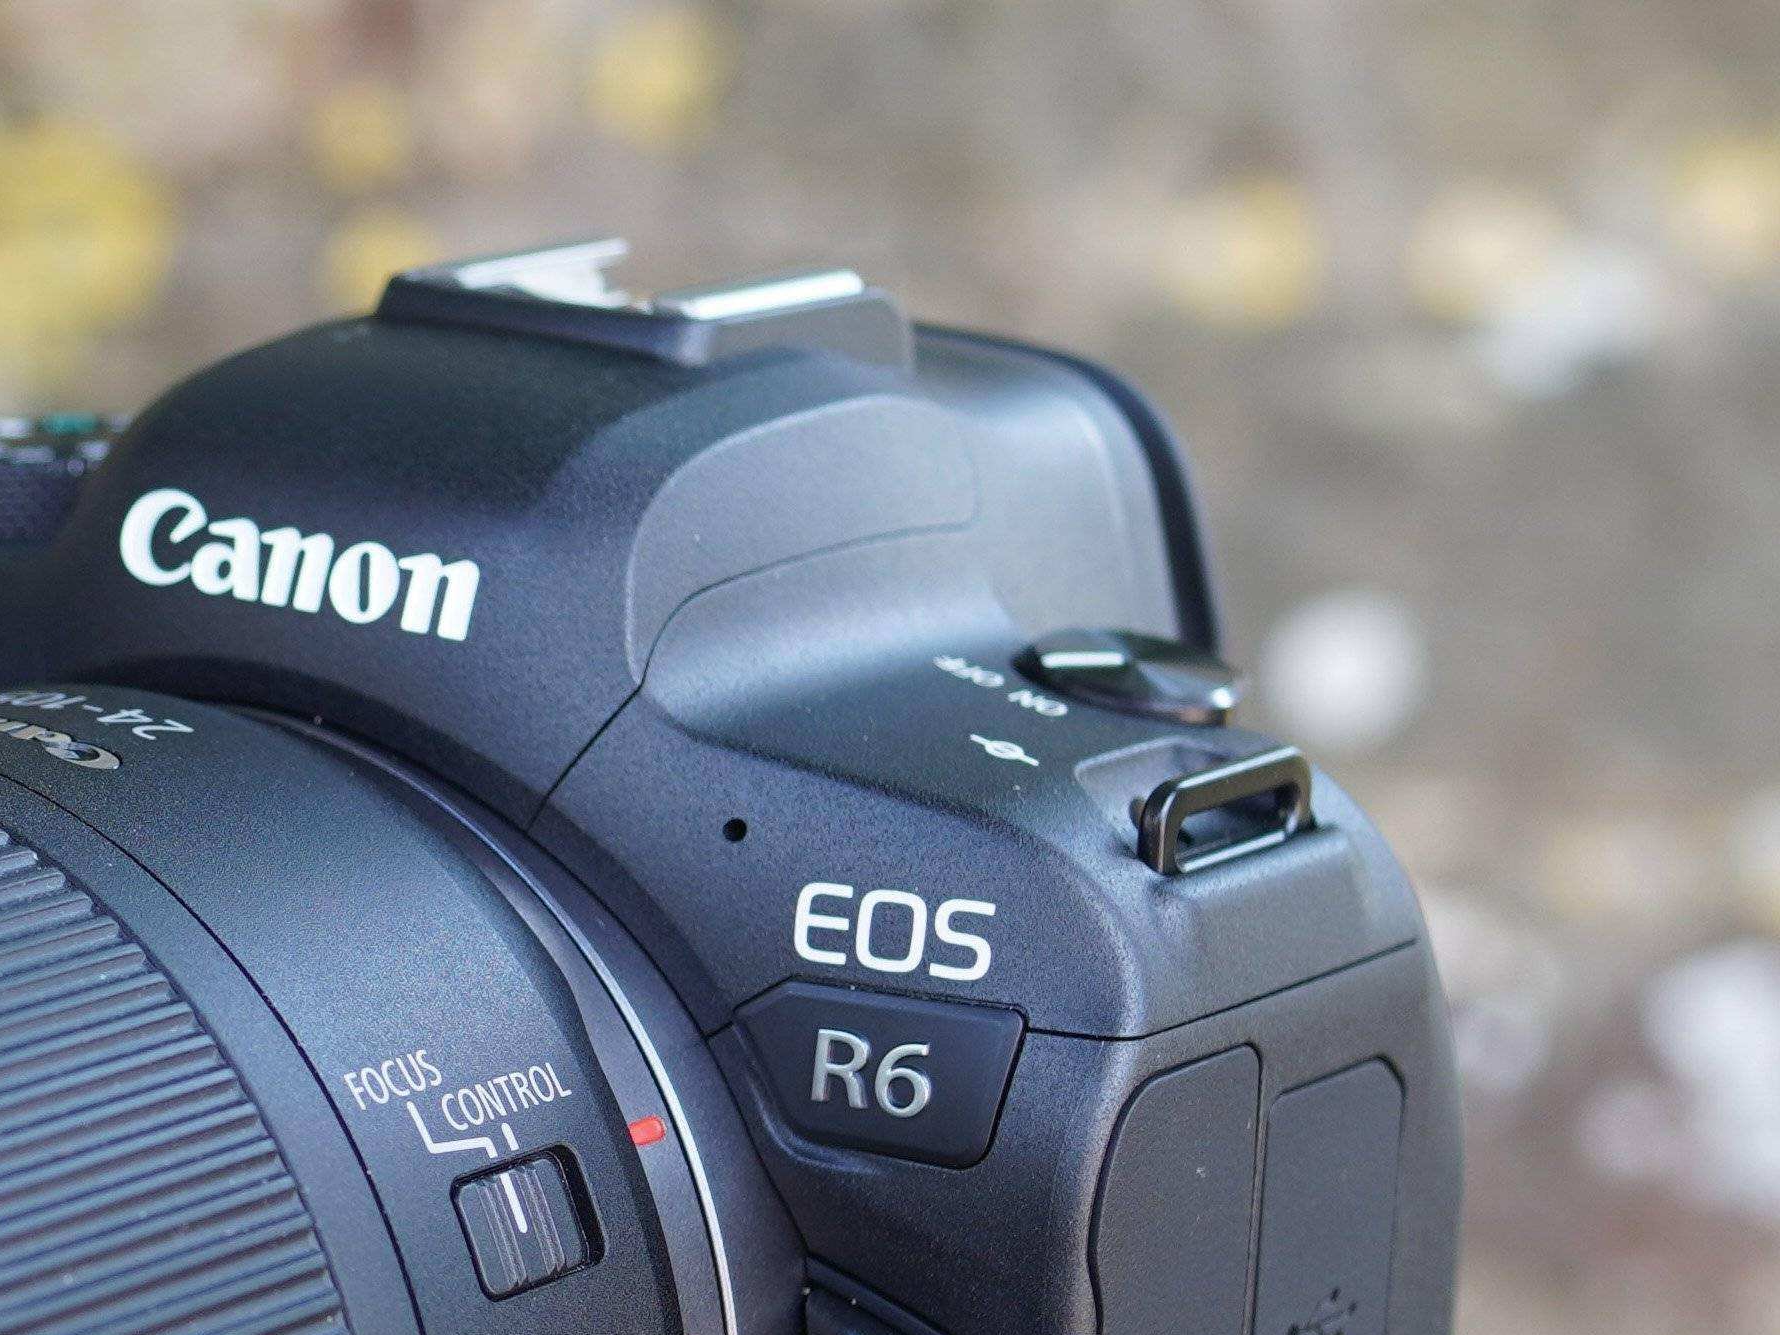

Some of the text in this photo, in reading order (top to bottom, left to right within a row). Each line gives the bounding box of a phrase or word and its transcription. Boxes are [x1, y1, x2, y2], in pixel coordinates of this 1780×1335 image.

[119, 487, 480, 642] Canon
[793, 882, 997, 981] EOS
[343, 1049, 443, 1111] FOCUS
[440, 1062, 572, 1131] CONTROL
[810, 1028, 932, 1118] R6
